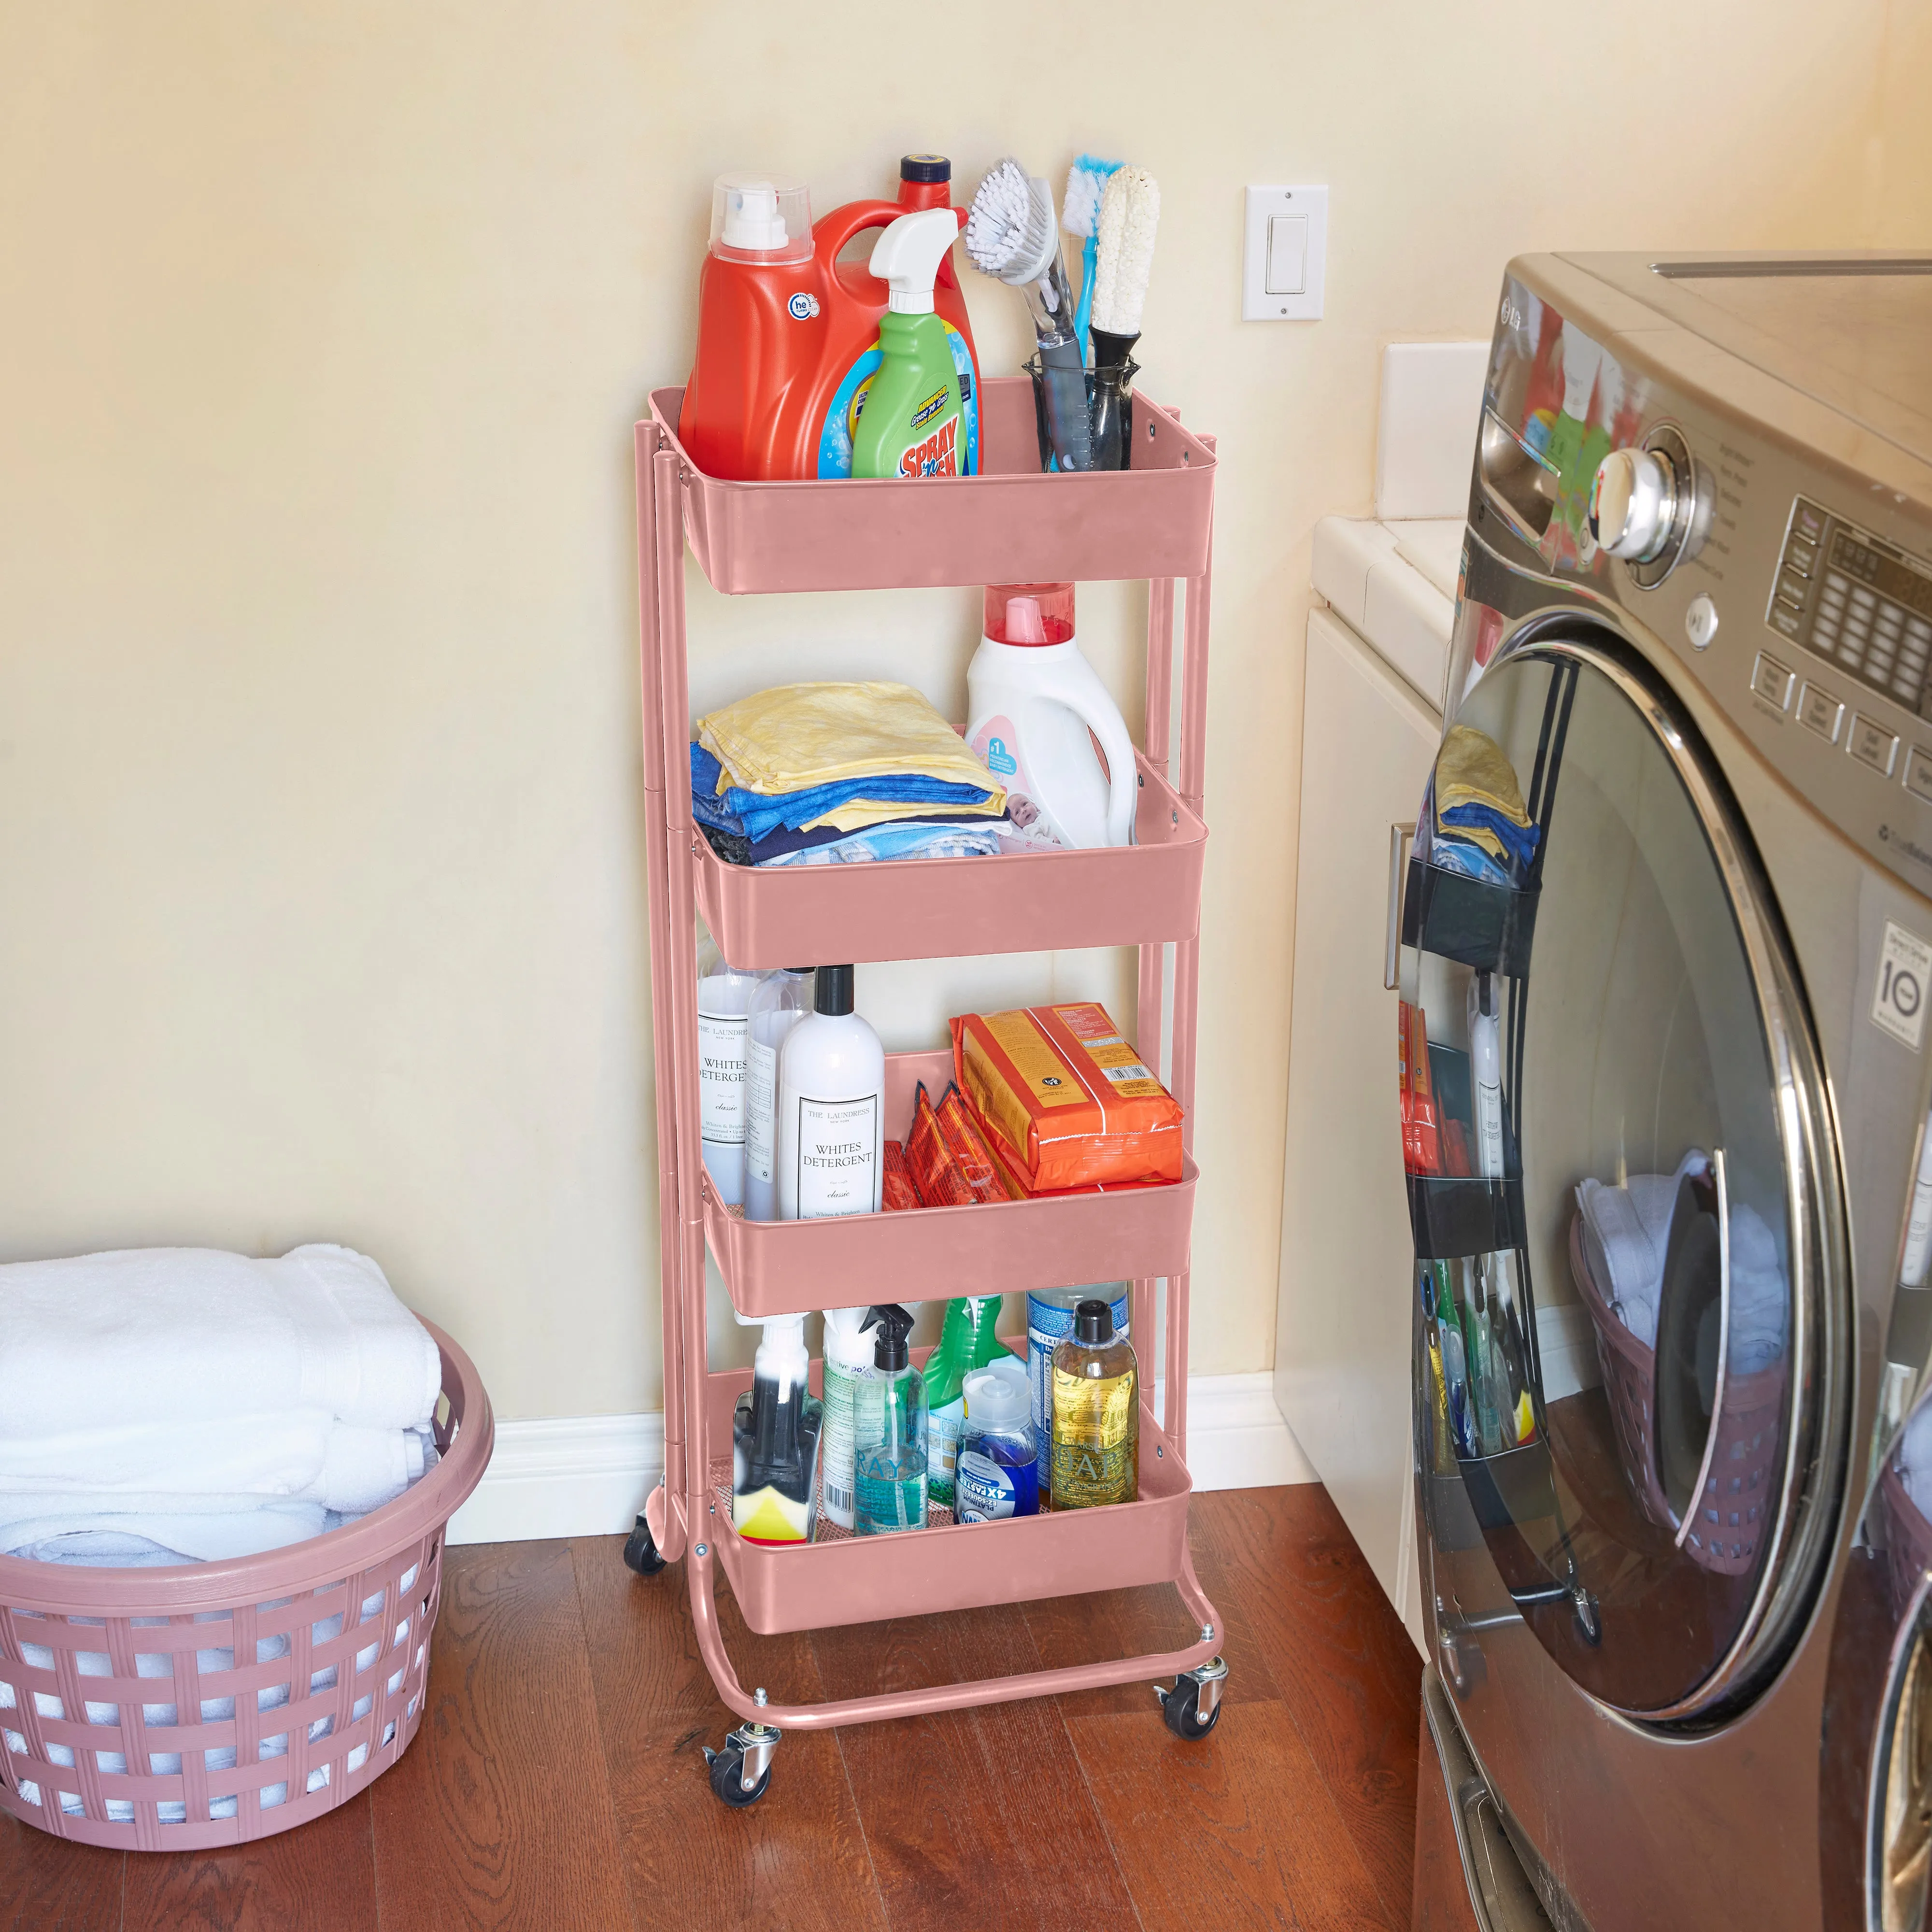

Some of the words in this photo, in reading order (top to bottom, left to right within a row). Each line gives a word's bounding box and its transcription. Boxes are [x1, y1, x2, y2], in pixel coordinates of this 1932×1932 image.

[795, 301, 807, 309] he
[958, 377, 968, 385] ED
[918, 385, 947, 413] ADVANCED
[911, 409, 928, 426] Grease
[916, 417, 927, 430] Stain
[927, 403, 944, 421] Removal
[902, 415, 958, 477] SPRAY
[991, 741, 999, 754] #1
[989, 753, 1009, 763] PEDIATRICIAN
[989, 758, 1012, 768] RECOMMENDED
[997, 765, 1014, 773] DETERGENT
[1881, 959, 1921, 1017] 10
[704, 1057, 747, 1069] WHITES
[715, 1103, 738, 1111] classic
[827, 1108, 870, 1119] LAUNDRESS
[815, 1142, 861, 1154] WHITES
[803, 1152, 872, 1167] DETERGENT
[857, 1449, 904, 1479] RAY
[960, 1473, 986, 1496] FASTER
[962, 1487, 997, 1507] EZ-SQUEEZE
[987, 1487, 1007, 1500] 4X
[963, 1494, 994, 1511] PLATINUM
